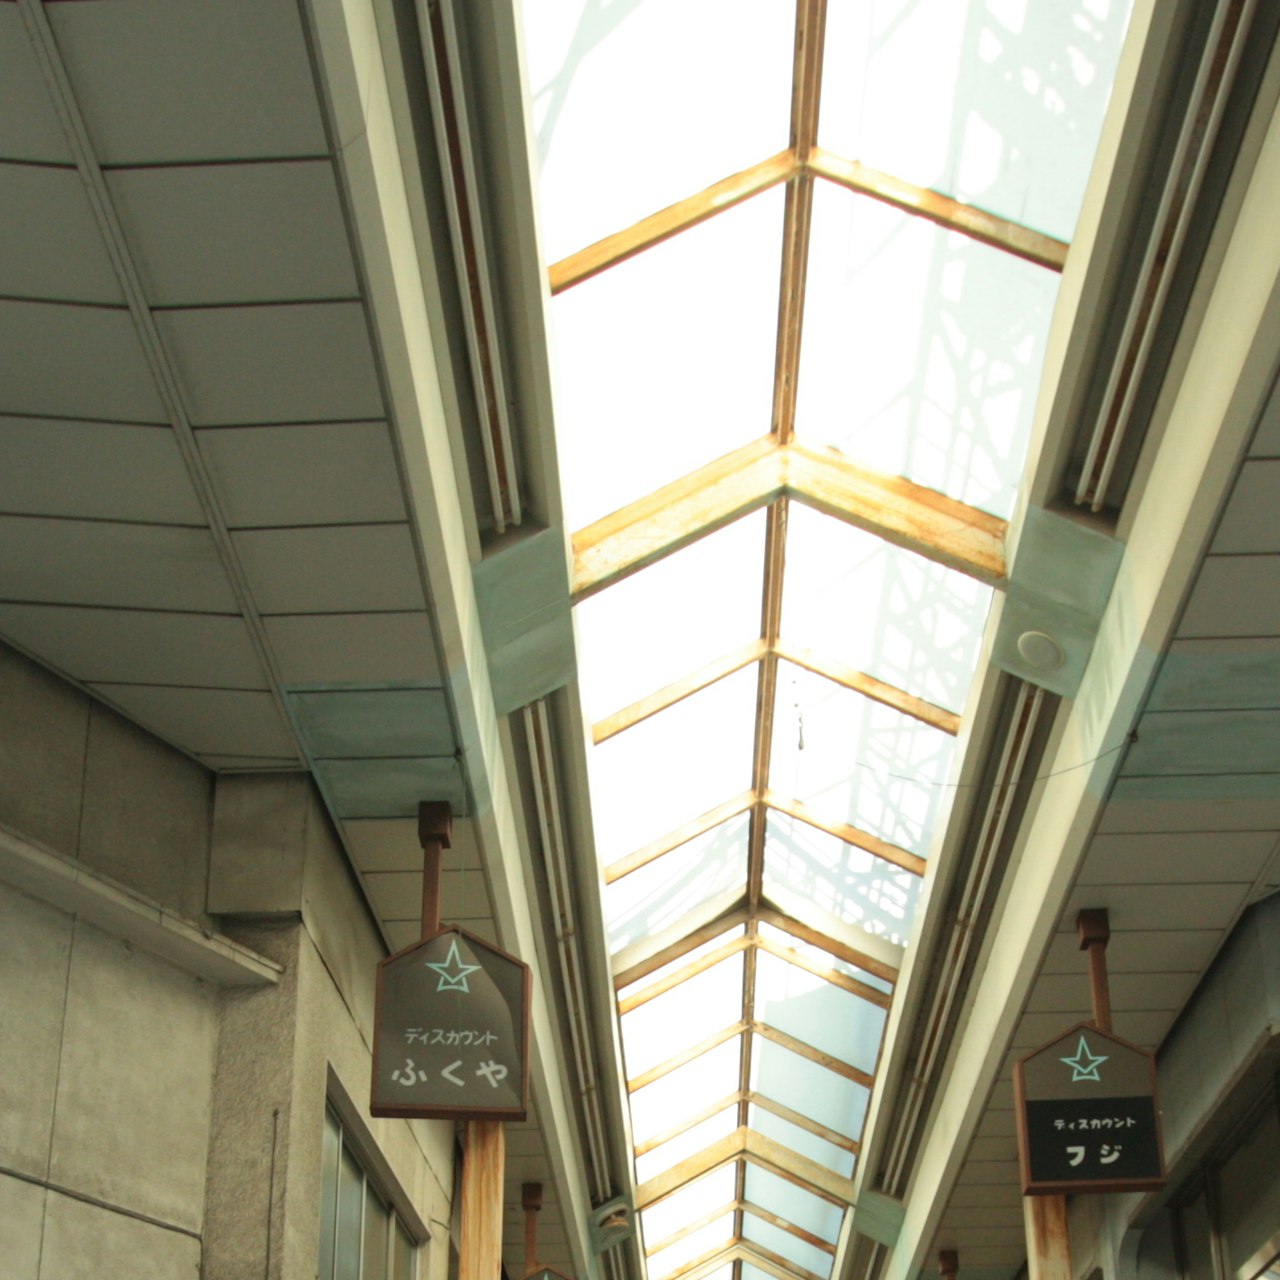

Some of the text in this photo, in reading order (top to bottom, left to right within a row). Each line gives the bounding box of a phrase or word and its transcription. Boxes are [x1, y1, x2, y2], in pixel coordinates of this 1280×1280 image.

[404, 1027, 499, 1047] ディスカウント
[391, 1058, 509, 1089] ふくや
[1053, 1116, 1137, 1131] ディスカウント
[1066, 1144, 1123, 1168] フジ
